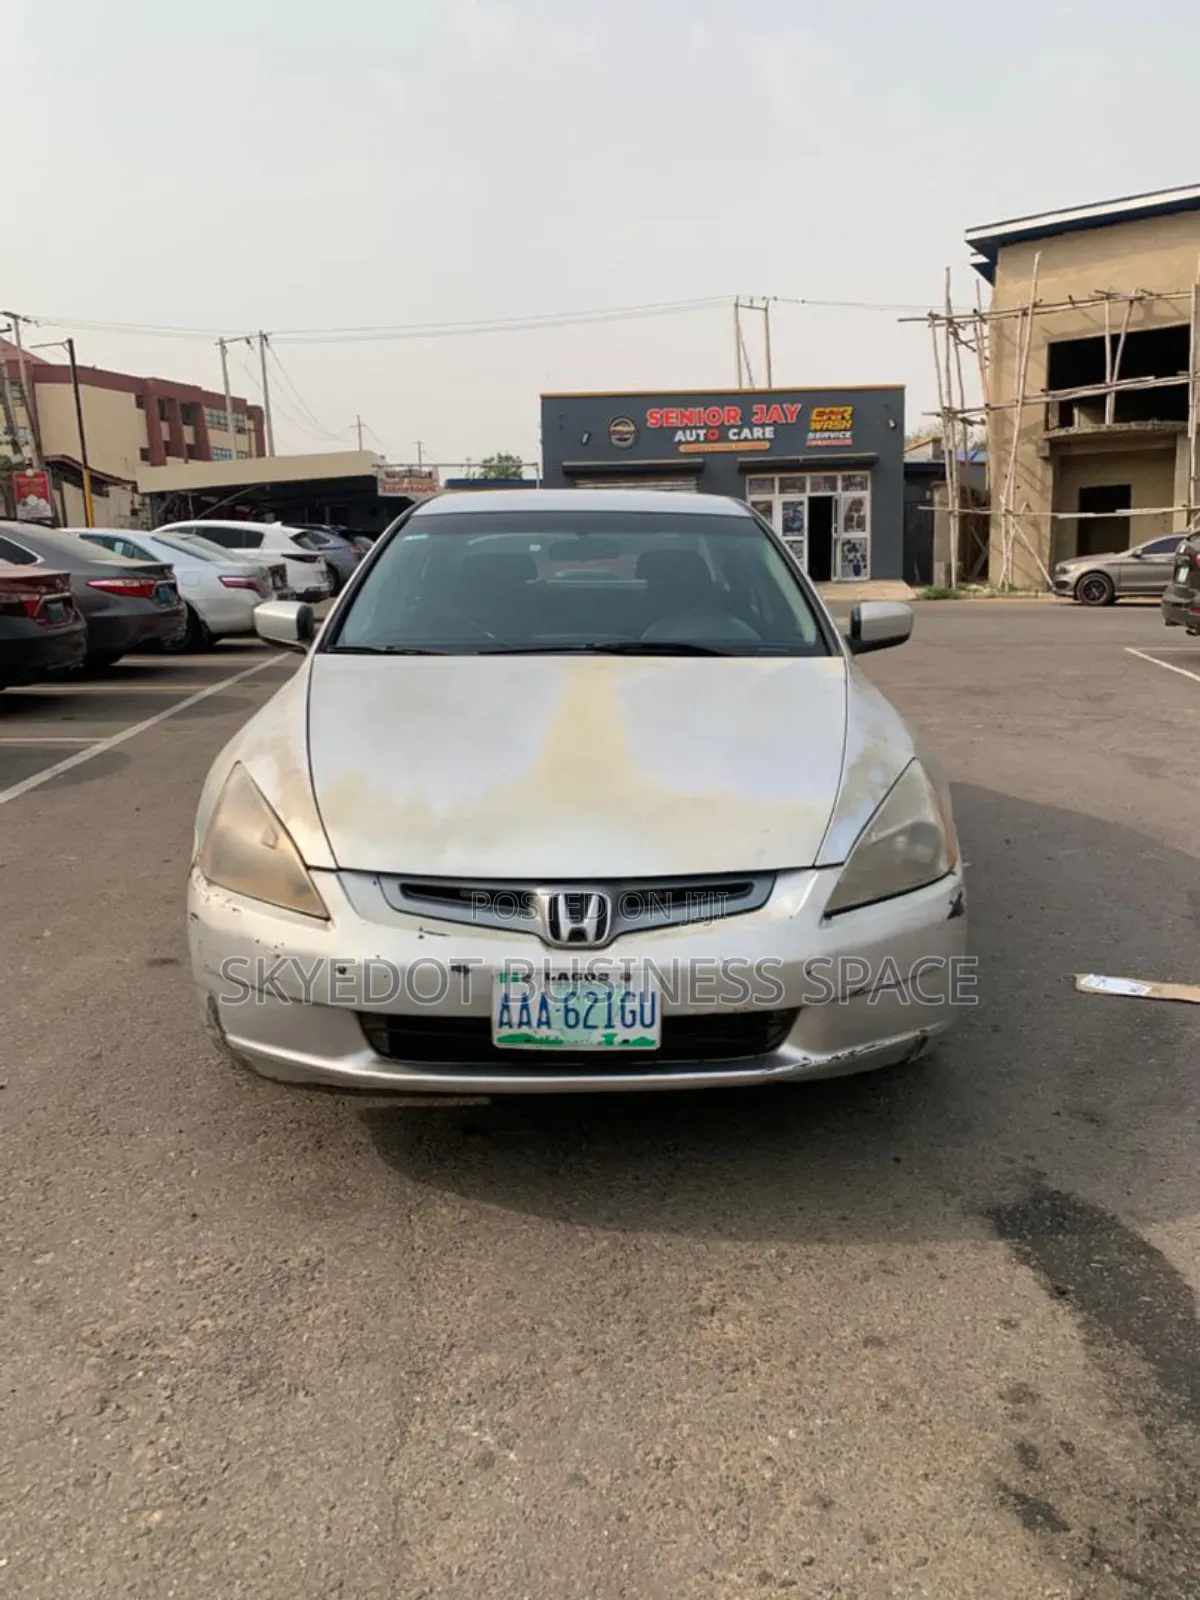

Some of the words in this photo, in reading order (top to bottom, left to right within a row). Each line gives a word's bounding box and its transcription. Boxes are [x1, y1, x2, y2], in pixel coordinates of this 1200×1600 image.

[646, 405, 742, 428] SENIOR
[751, 403, 802, 425] JAY
[673, 427, 719, 442] AUTO
[728, 426, 775, 440] CARE
[544, 971, 610, 983] LAGOS
